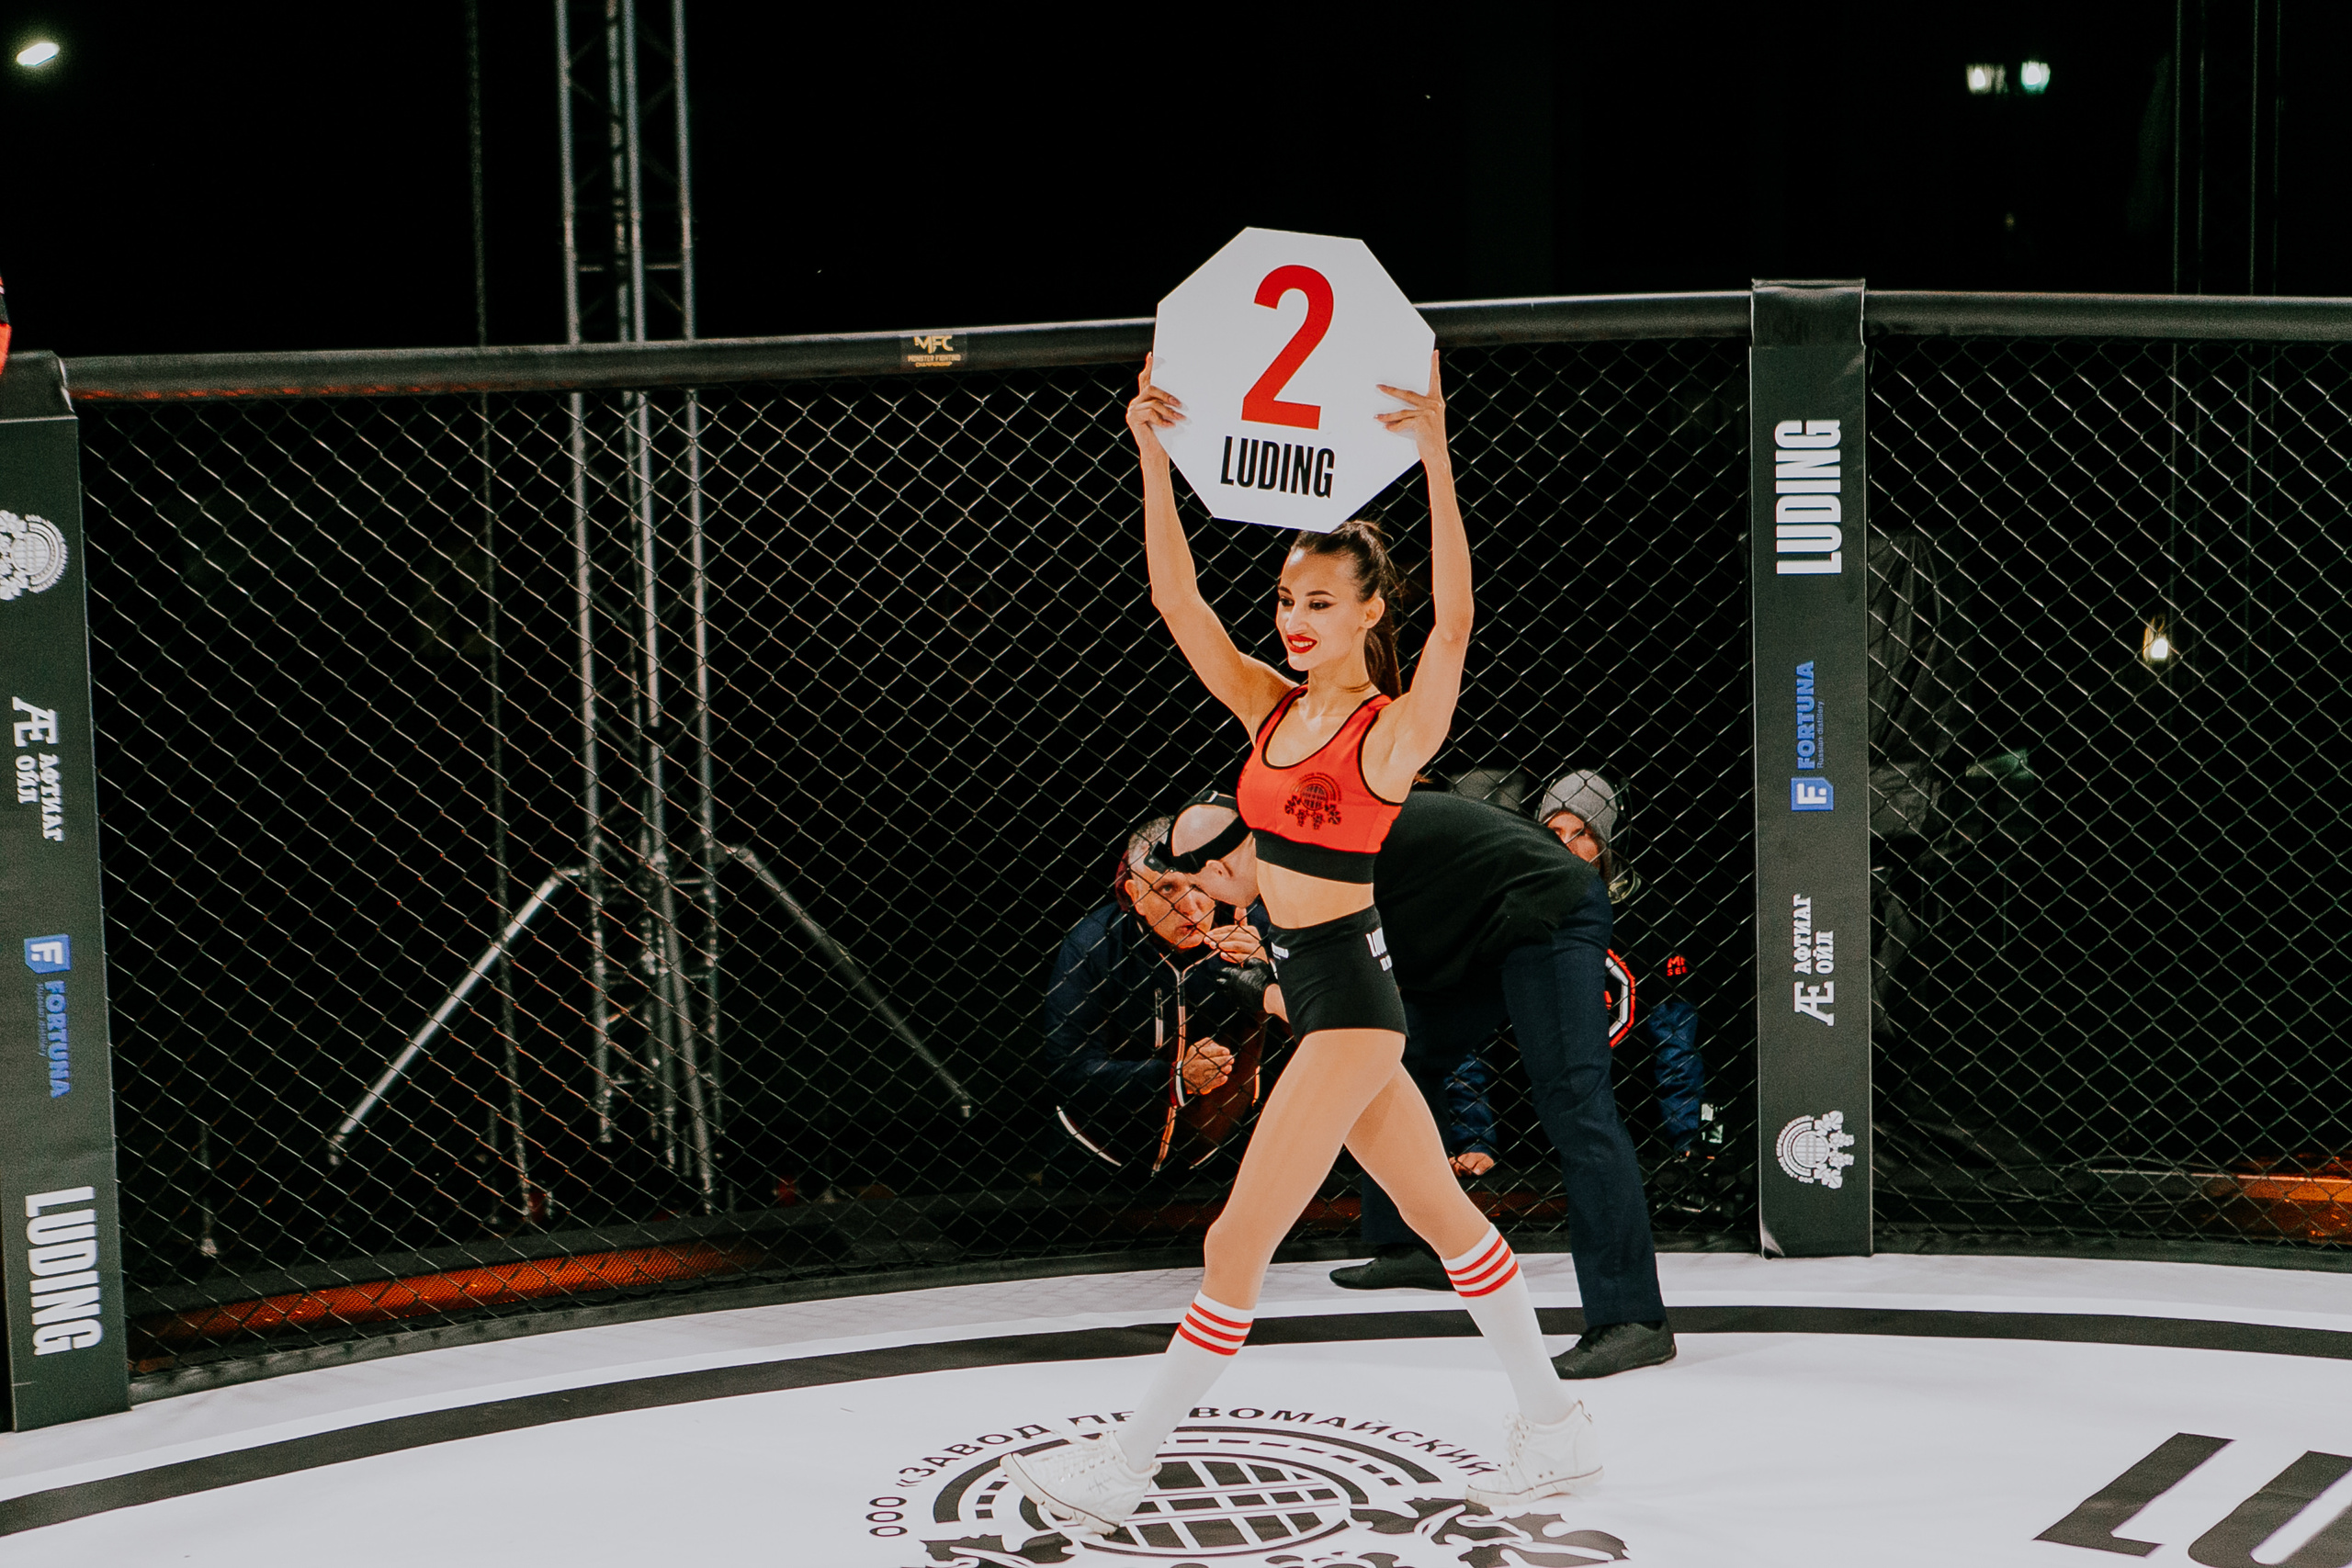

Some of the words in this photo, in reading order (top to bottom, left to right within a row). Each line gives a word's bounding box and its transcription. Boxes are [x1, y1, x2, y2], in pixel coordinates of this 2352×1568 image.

[913, 335, 954, 354] MFC
[1241, 264, 1335, 430] 2
[1220, 435, 1335, 499] LUDING
[1775, 420, 1842, 574] LUDING
[1796, 660, 1815, 770] FORTUNA
[1813, 931, 1835, 975] ОЙЛ
[44, 979, 72, 1099] FORTUNA
[25, 1185, 104, 1356] LUDING
[865, 1496, 909, 1538] ООО
